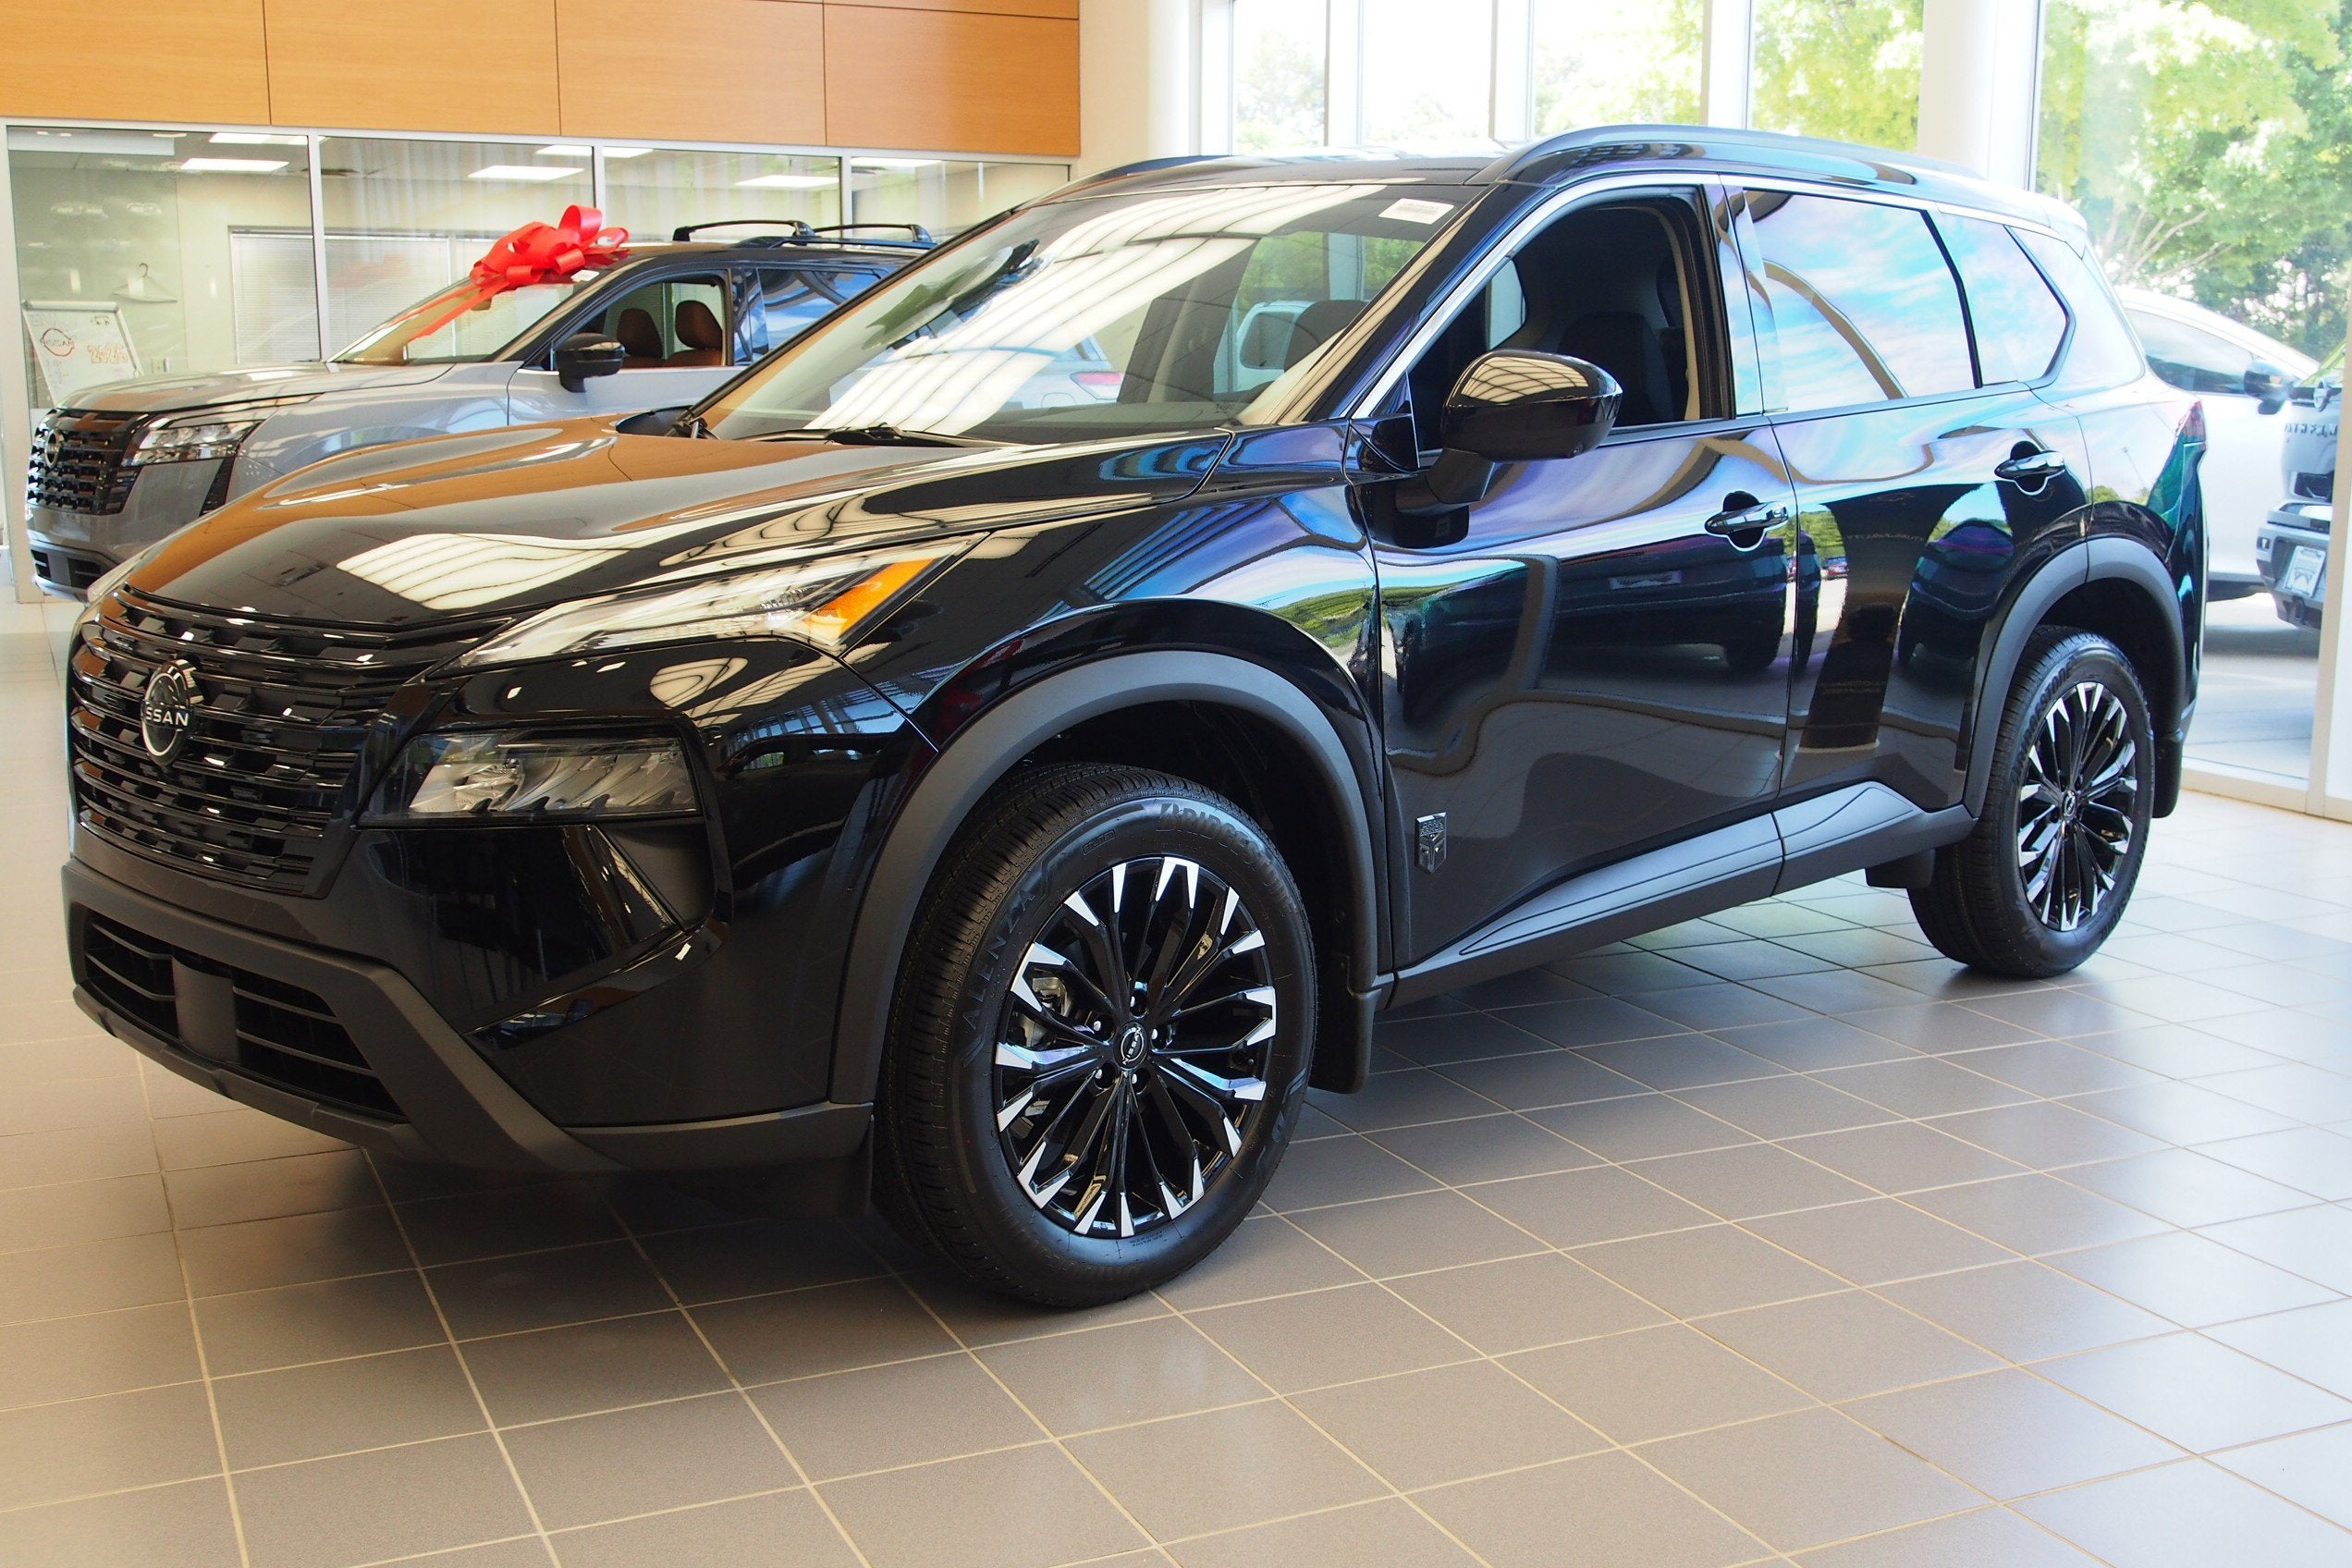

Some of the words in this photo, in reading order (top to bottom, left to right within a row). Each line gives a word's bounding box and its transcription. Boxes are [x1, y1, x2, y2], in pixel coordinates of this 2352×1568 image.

[144, 705, 190, 727] SSAN
[962, 889, 1035, 1030] ALENZA
[1121, 1026, 1142, 1065] NISSAN
